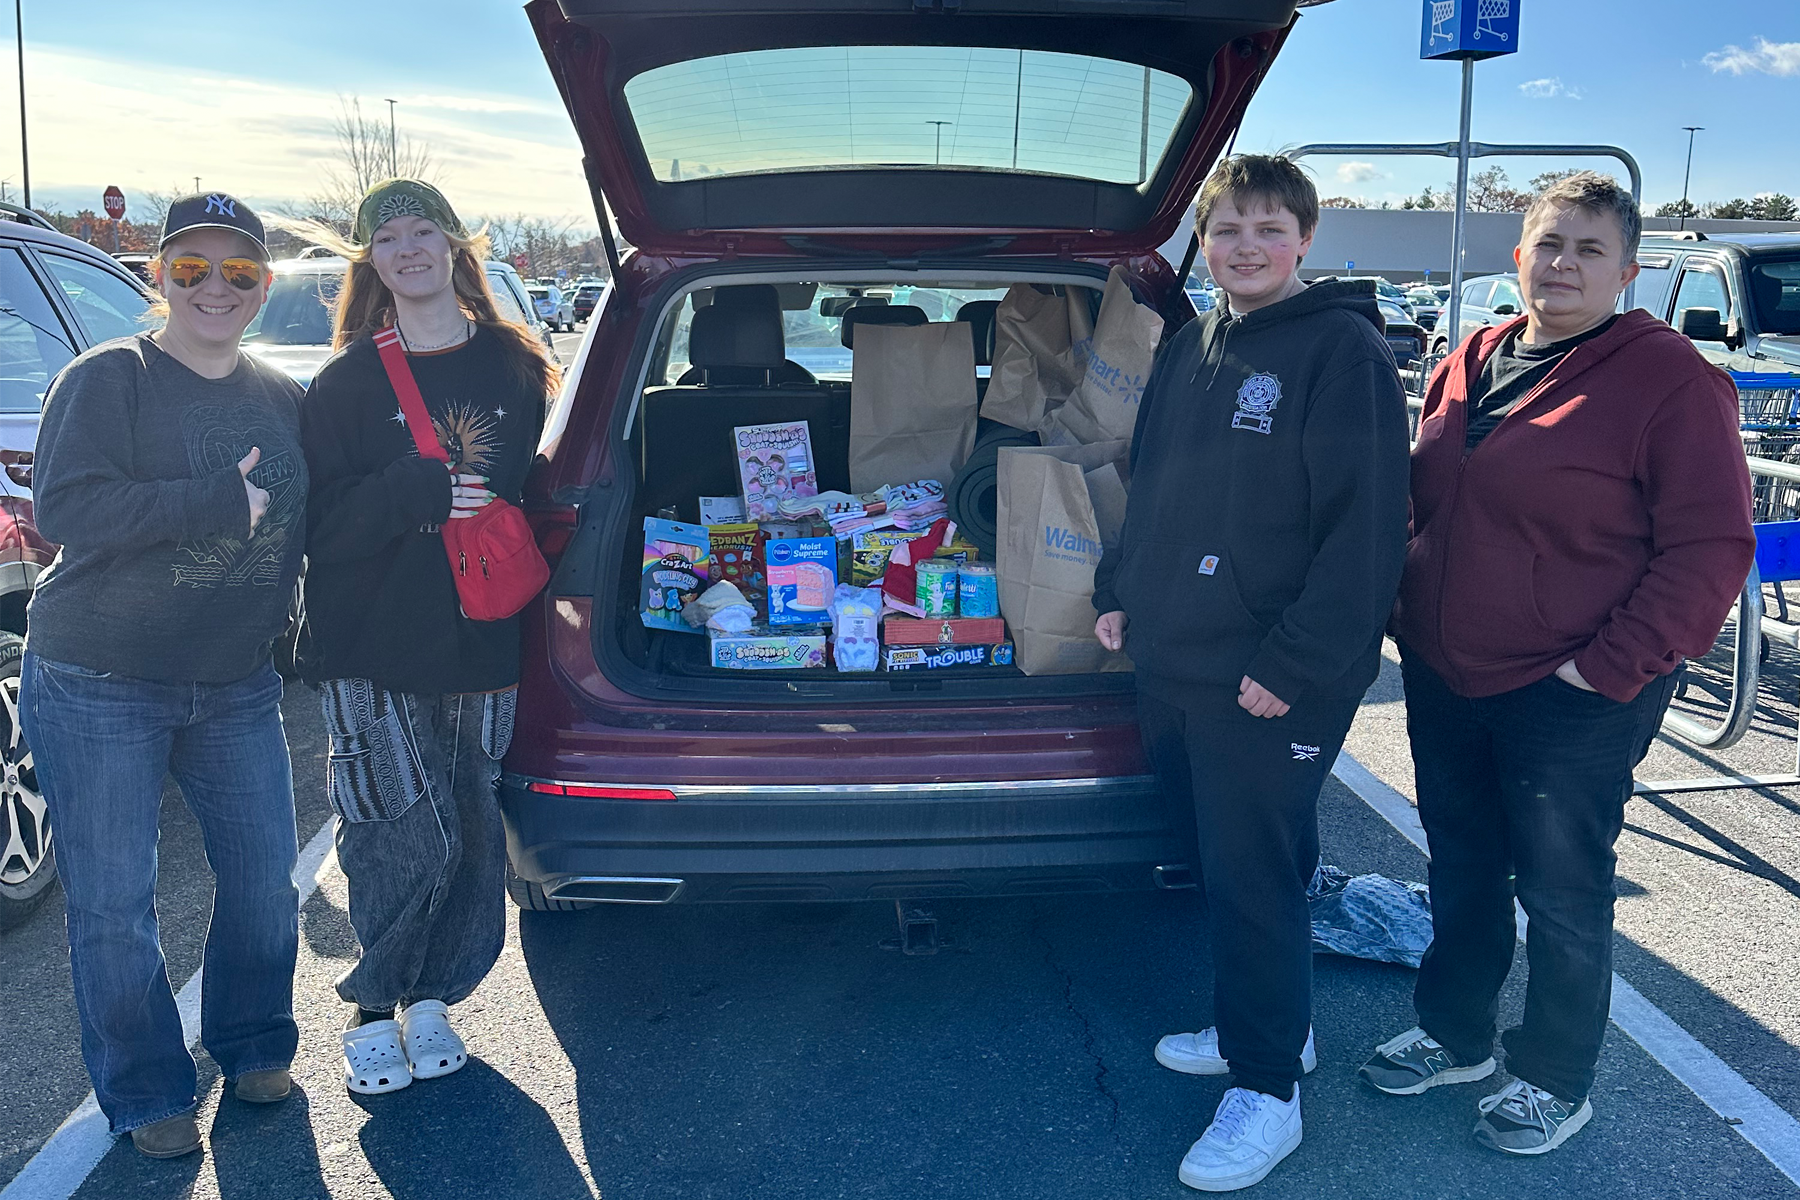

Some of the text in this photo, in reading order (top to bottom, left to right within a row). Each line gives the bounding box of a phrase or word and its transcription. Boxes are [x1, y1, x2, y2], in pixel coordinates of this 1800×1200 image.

[104, 195, 124, 209] STOP
[205, 193, 236, 218] NY
[248, 456, 295, 487] TTHEWS
[710, 532, 758, 547] EDBANZ
[799, 542, 821, 551] Moist
[1045, 525, 1104, 558] Walma
[793, 549, 829, 559] Supreme
[1045, 550, 1060, 559] Save
[892, 651, 919, 660] SONIC
[926, 647, 985, 668] TROUBLE
[1290, 742, 1320, 752] Reebok
